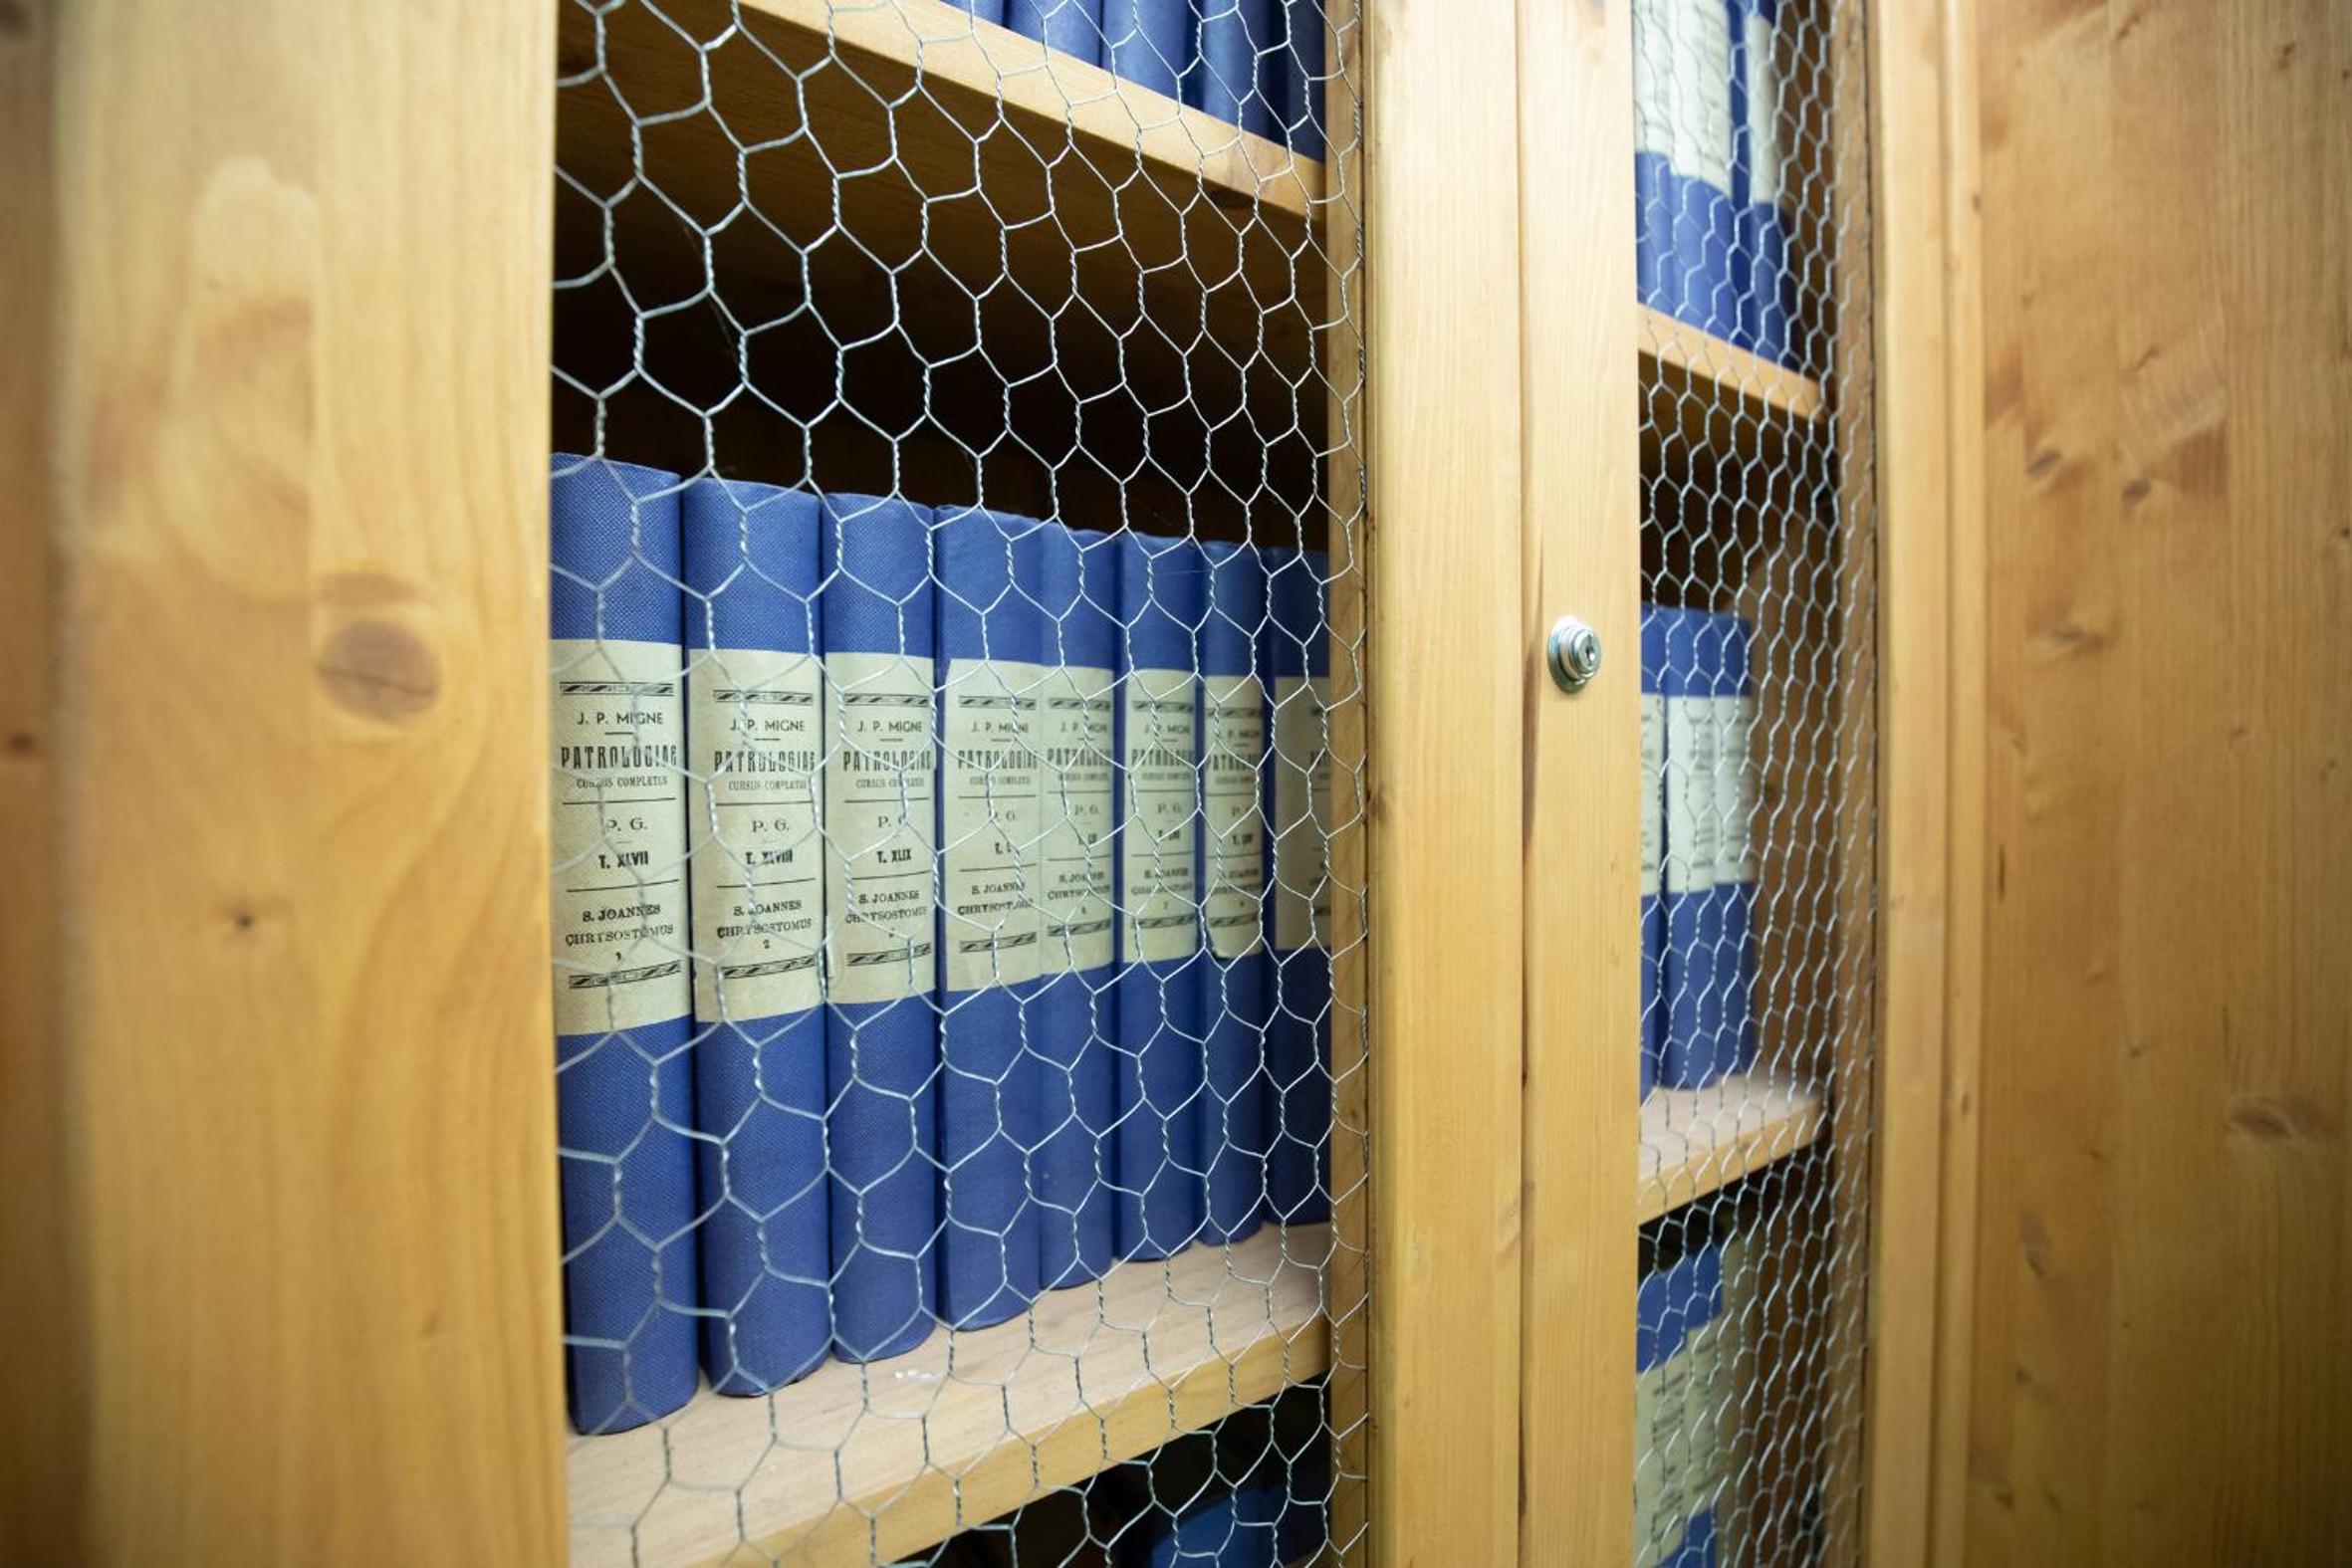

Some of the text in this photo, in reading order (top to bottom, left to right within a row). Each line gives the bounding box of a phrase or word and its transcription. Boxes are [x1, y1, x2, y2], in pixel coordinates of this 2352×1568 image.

[577, 711, 664, 726] J. P. MIGNE
[747, 719, 758, 731] P.
[764, 719, 805, 732] MIGNE
[857, 720, 923, 733] J. P. MIGNE
[998, 722, 1030, 734] MINE
[628, 816, 648, 830] G.
[752, 818, 791, 833] P. G.
[597, 854, 611, 870] T.
[876, 850, 888, 864] T.
[582, 904, 662, 923] S. JOANNES
